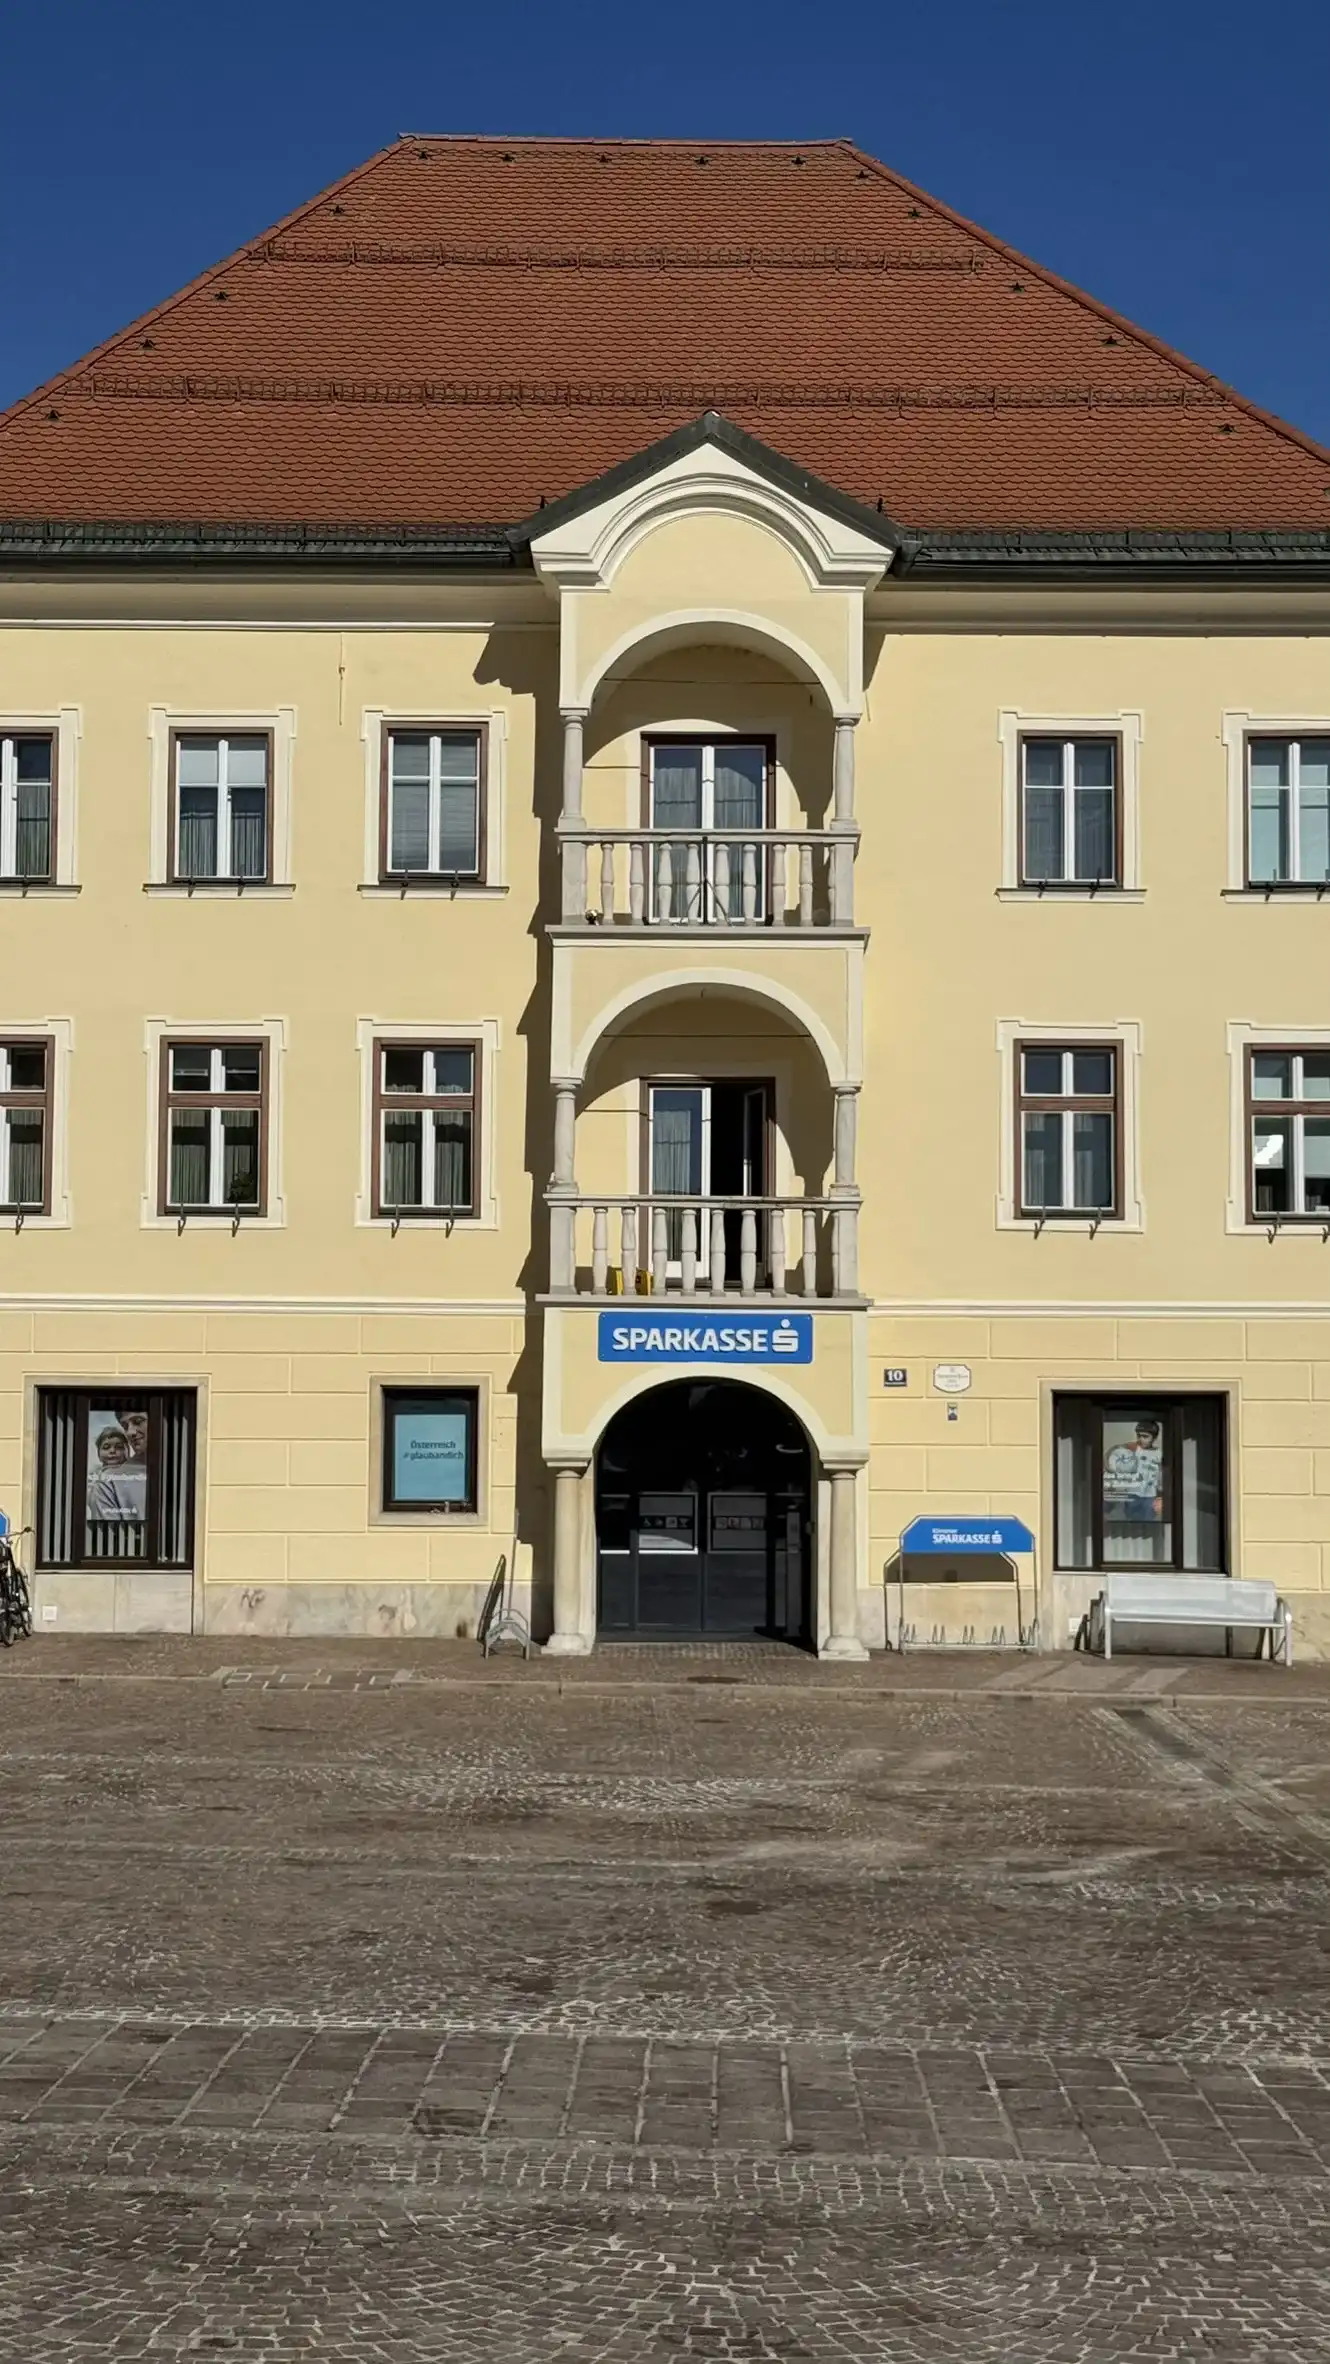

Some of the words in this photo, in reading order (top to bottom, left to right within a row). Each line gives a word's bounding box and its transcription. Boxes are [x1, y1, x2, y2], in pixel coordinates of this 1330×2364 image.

[612, 1328, 769, 1353] SPARKASSE
[887, 1370, 904, 1382] 10
[410, 1440, 456, 1449] Österreich
[932, 1533, 991, 1545] SPARKASSE
